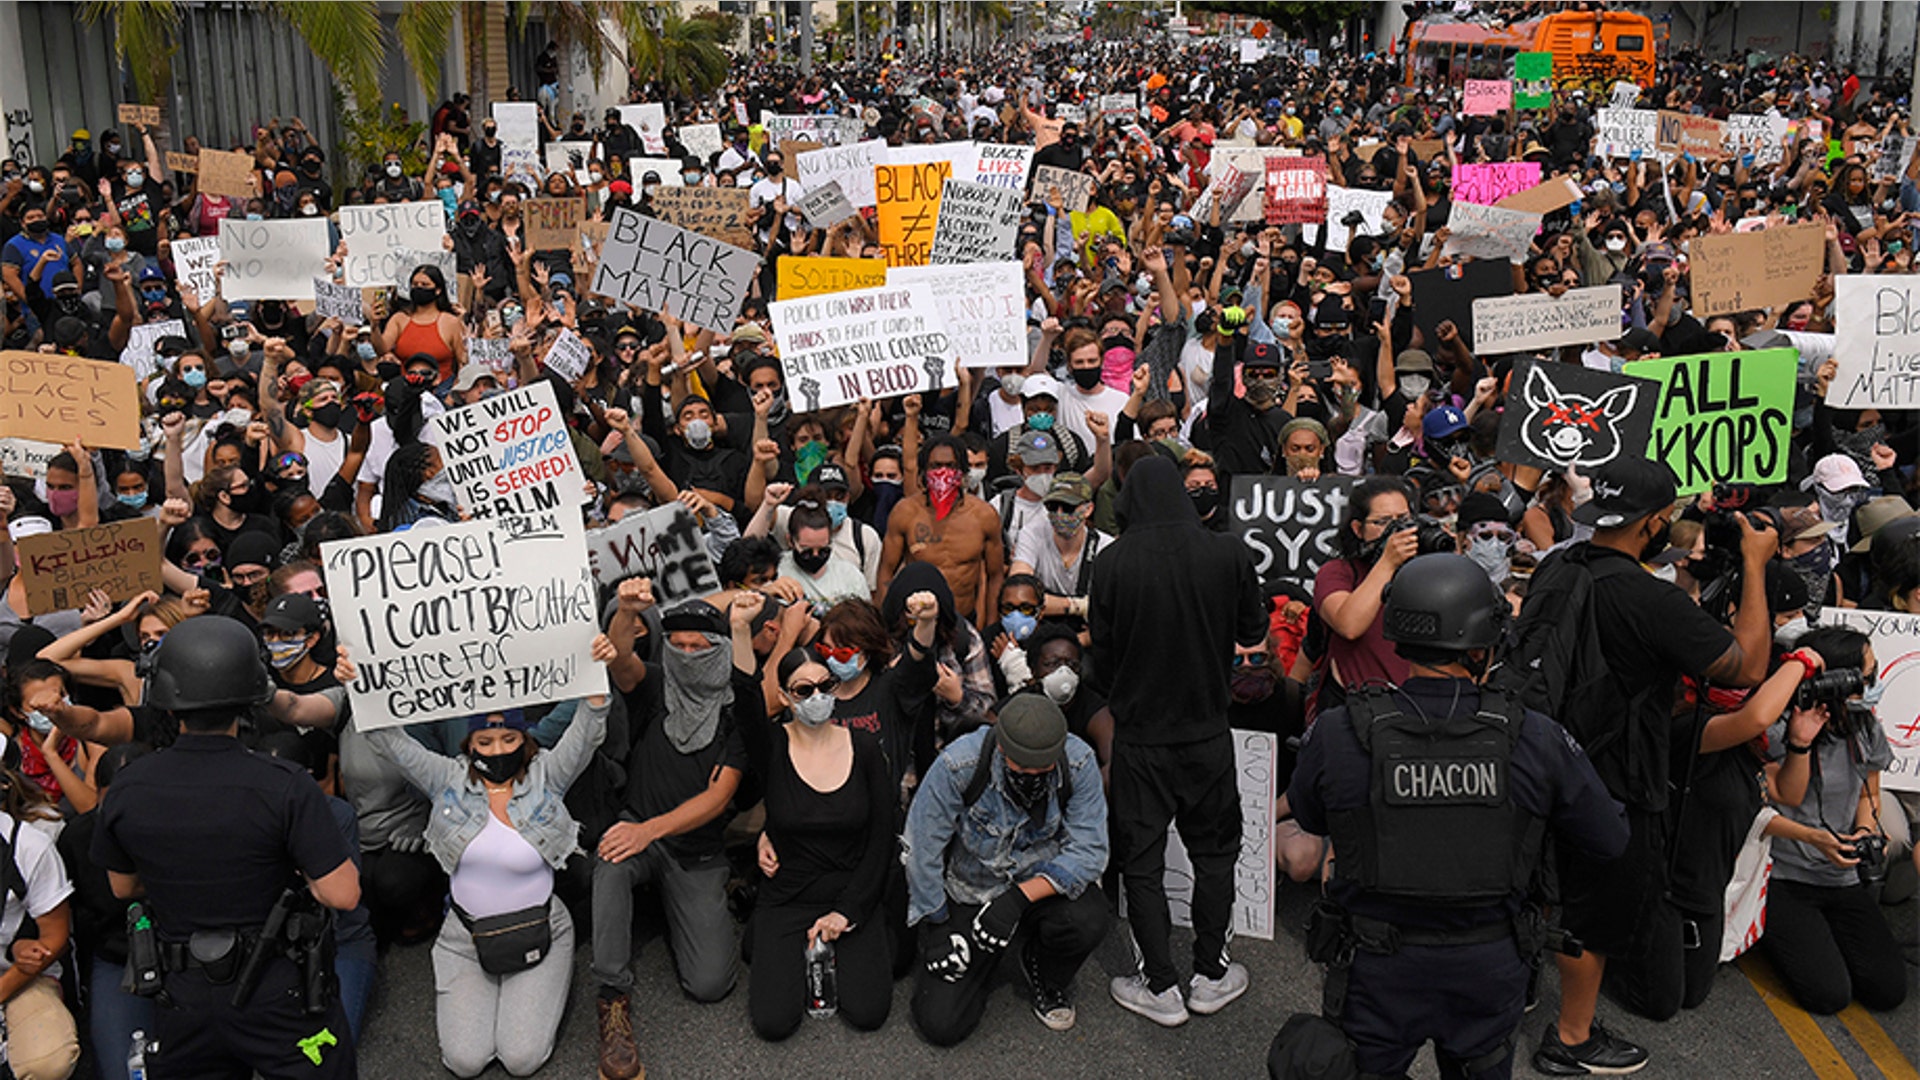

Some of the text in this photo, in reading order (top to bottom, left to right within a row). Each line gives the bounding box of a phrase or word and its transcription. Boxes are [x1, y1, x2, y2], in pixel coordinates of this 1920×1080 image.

[1659, 115, 1681, 145] NO
[977, 159, 1024, 174] LIVES
[981, 146, 1027, 161] BLACK
[876, 162, 951, 205] BLACK
[943, 179, 1002, 206] NOBODY
[1268, 169, 1316, 186] NEVER
[1275, 183, 1323, 201] AGAIN
[343, 203, 441, 236] JUSTICE
[941, 201, 996, 219] HISTORY
[225, 222, 270, 250] NO
[613, 210, 733, 275] BLACK
[185, 254, 214, 270] WE
[225, 258, 263, 280] NO
[880, 241, 931, 267] THRE
[631, 249, 737, 305] LIVES
[596, 263, 732, 333] MATTER
[783, 302, 821, 326] POLICE
[877, 290, 913, 312] THEIR
[850, 341, 887, 365] STILL
[887, 332, 951, 361] COVERED
[1254, 343, 1268, 358] C
[0, 358, 111, 382] OTECT
[837, 363, 919, 400] IN BLOOD
[1660, 357, 1760, 420] ALL
[437, 390, 539, 436] WE WILL
[445, 406, 553, 460] NOT STOP
[1650, 407, 1788, 489] KKOPS
[447, 454, 500, 486] UNTIL
[466, 453, 575, 505] IS SERVED!
[52, 523, 123, 552] STOP
[1243, 528, 1341, 575] SYS
[30, 537, 146, 576] KILLING
[54, 559, 129, 583] BLACK
[359, 608, 377, 656] I
[388, 675, 498, 719] George
[1393, 762, 1497, 798] CHACON
